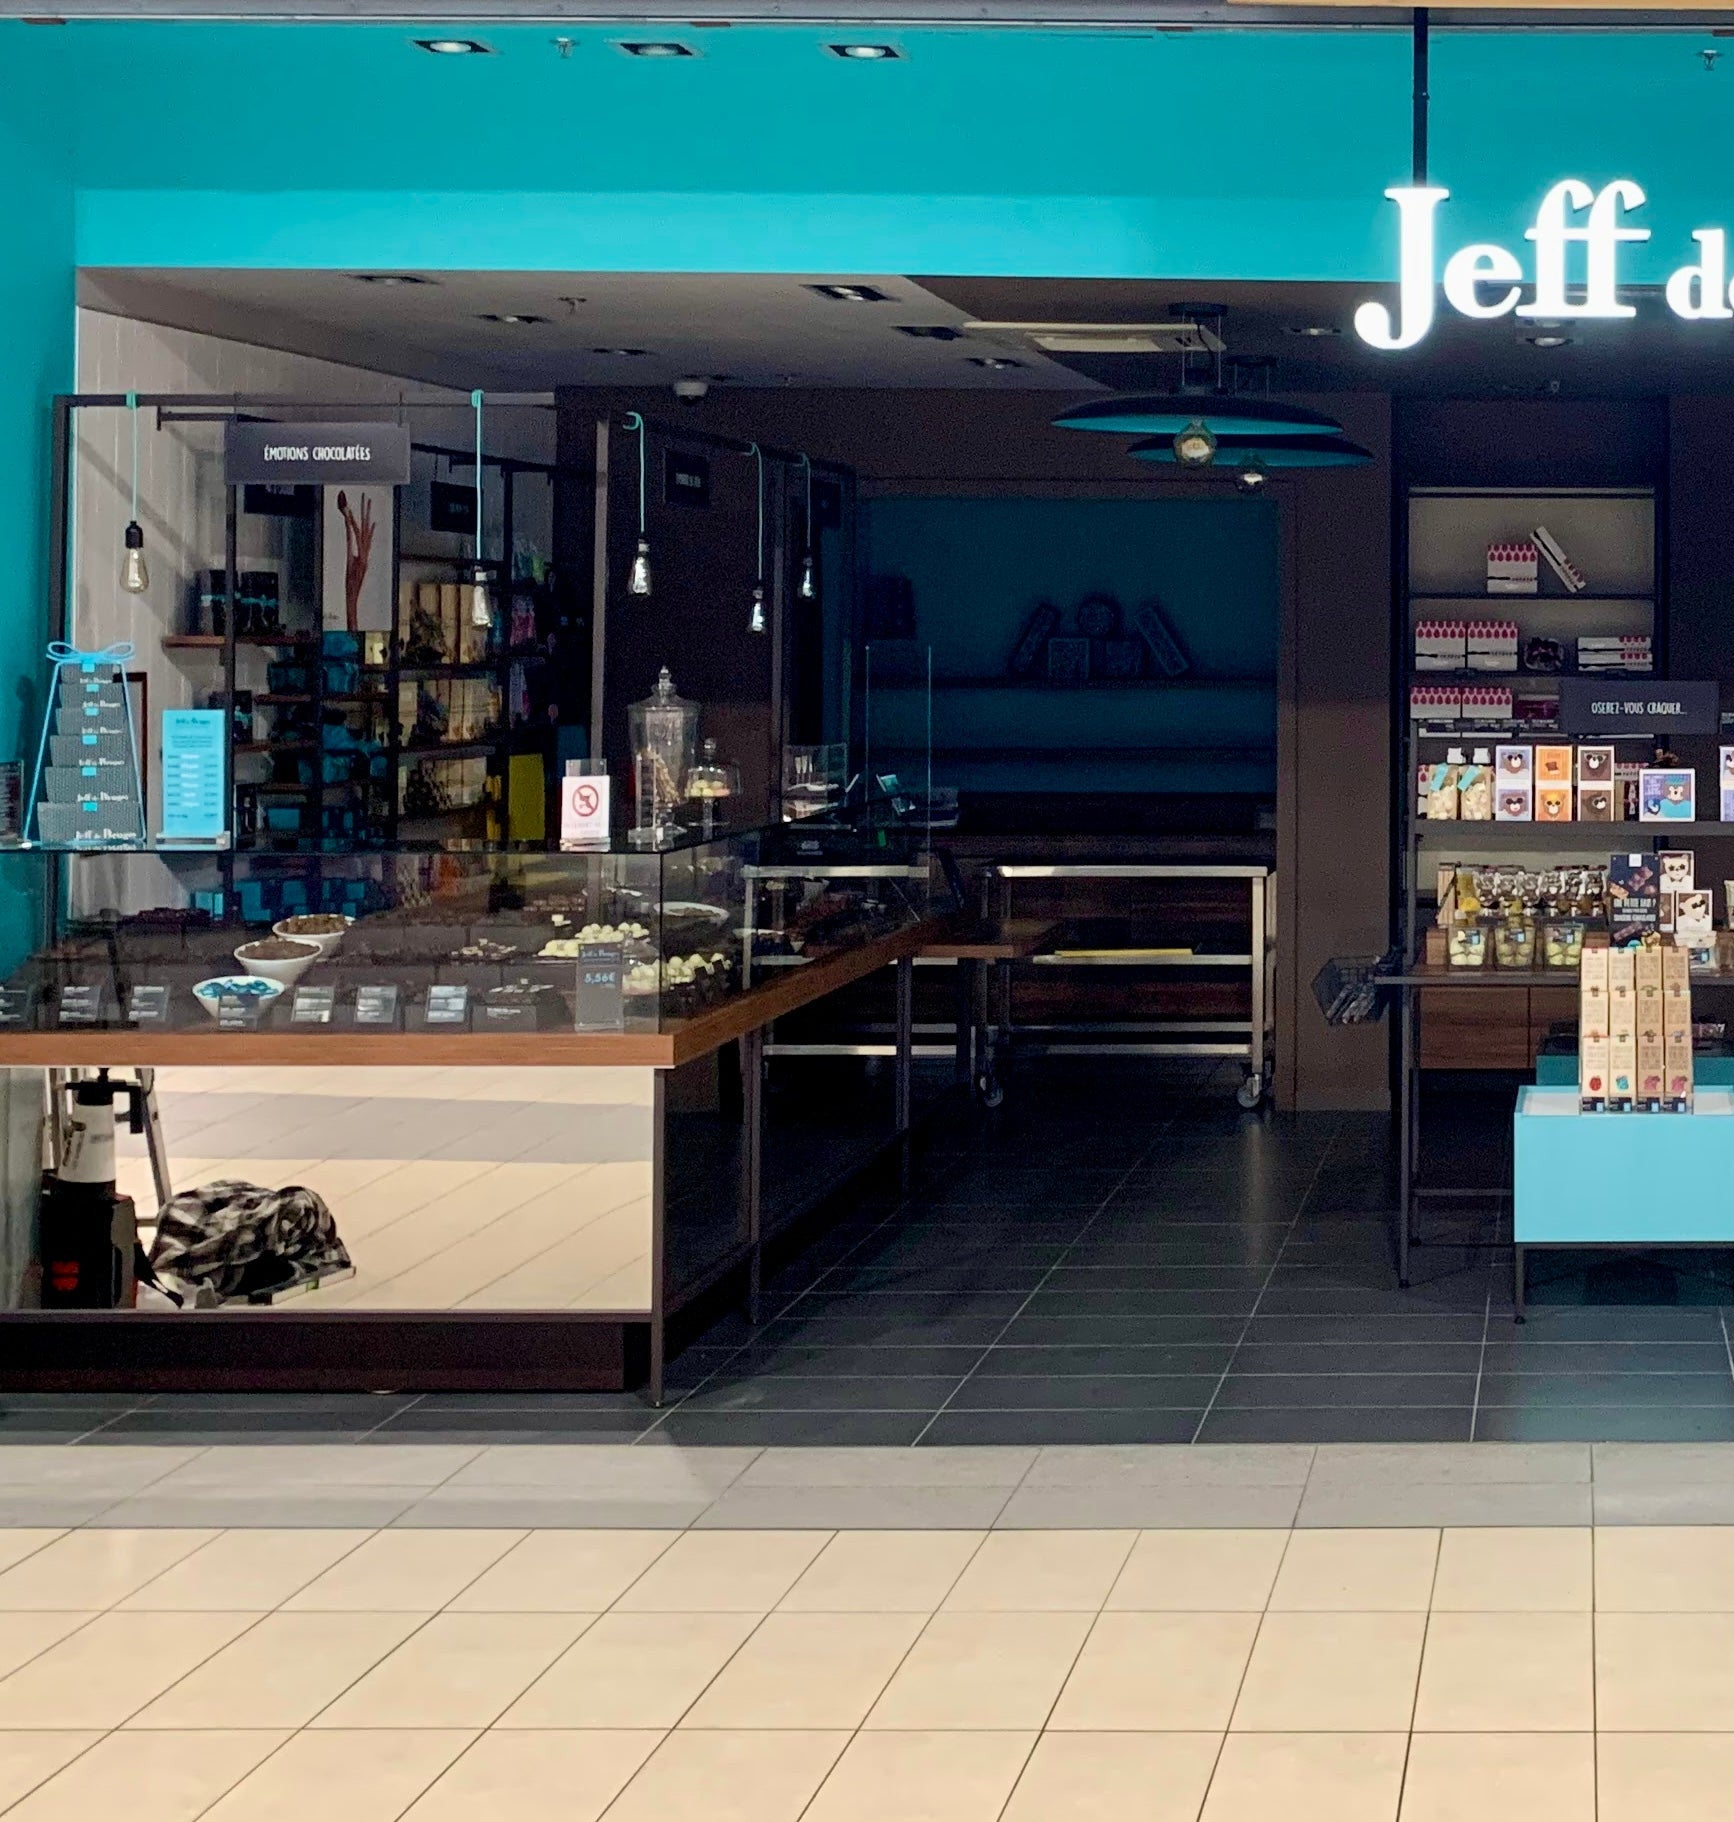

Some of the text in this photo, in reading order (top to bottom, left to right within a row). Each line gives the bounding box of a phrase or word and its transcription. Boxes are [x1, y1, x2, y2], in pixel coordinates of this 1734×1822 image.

[1354, 178, 1652, 350] Jeff
[263, 443, 371, 462] ÉMOTIONS CHOCOLATÉES
[1591, 701, 1644, 715] OSEREZ-VOUS
